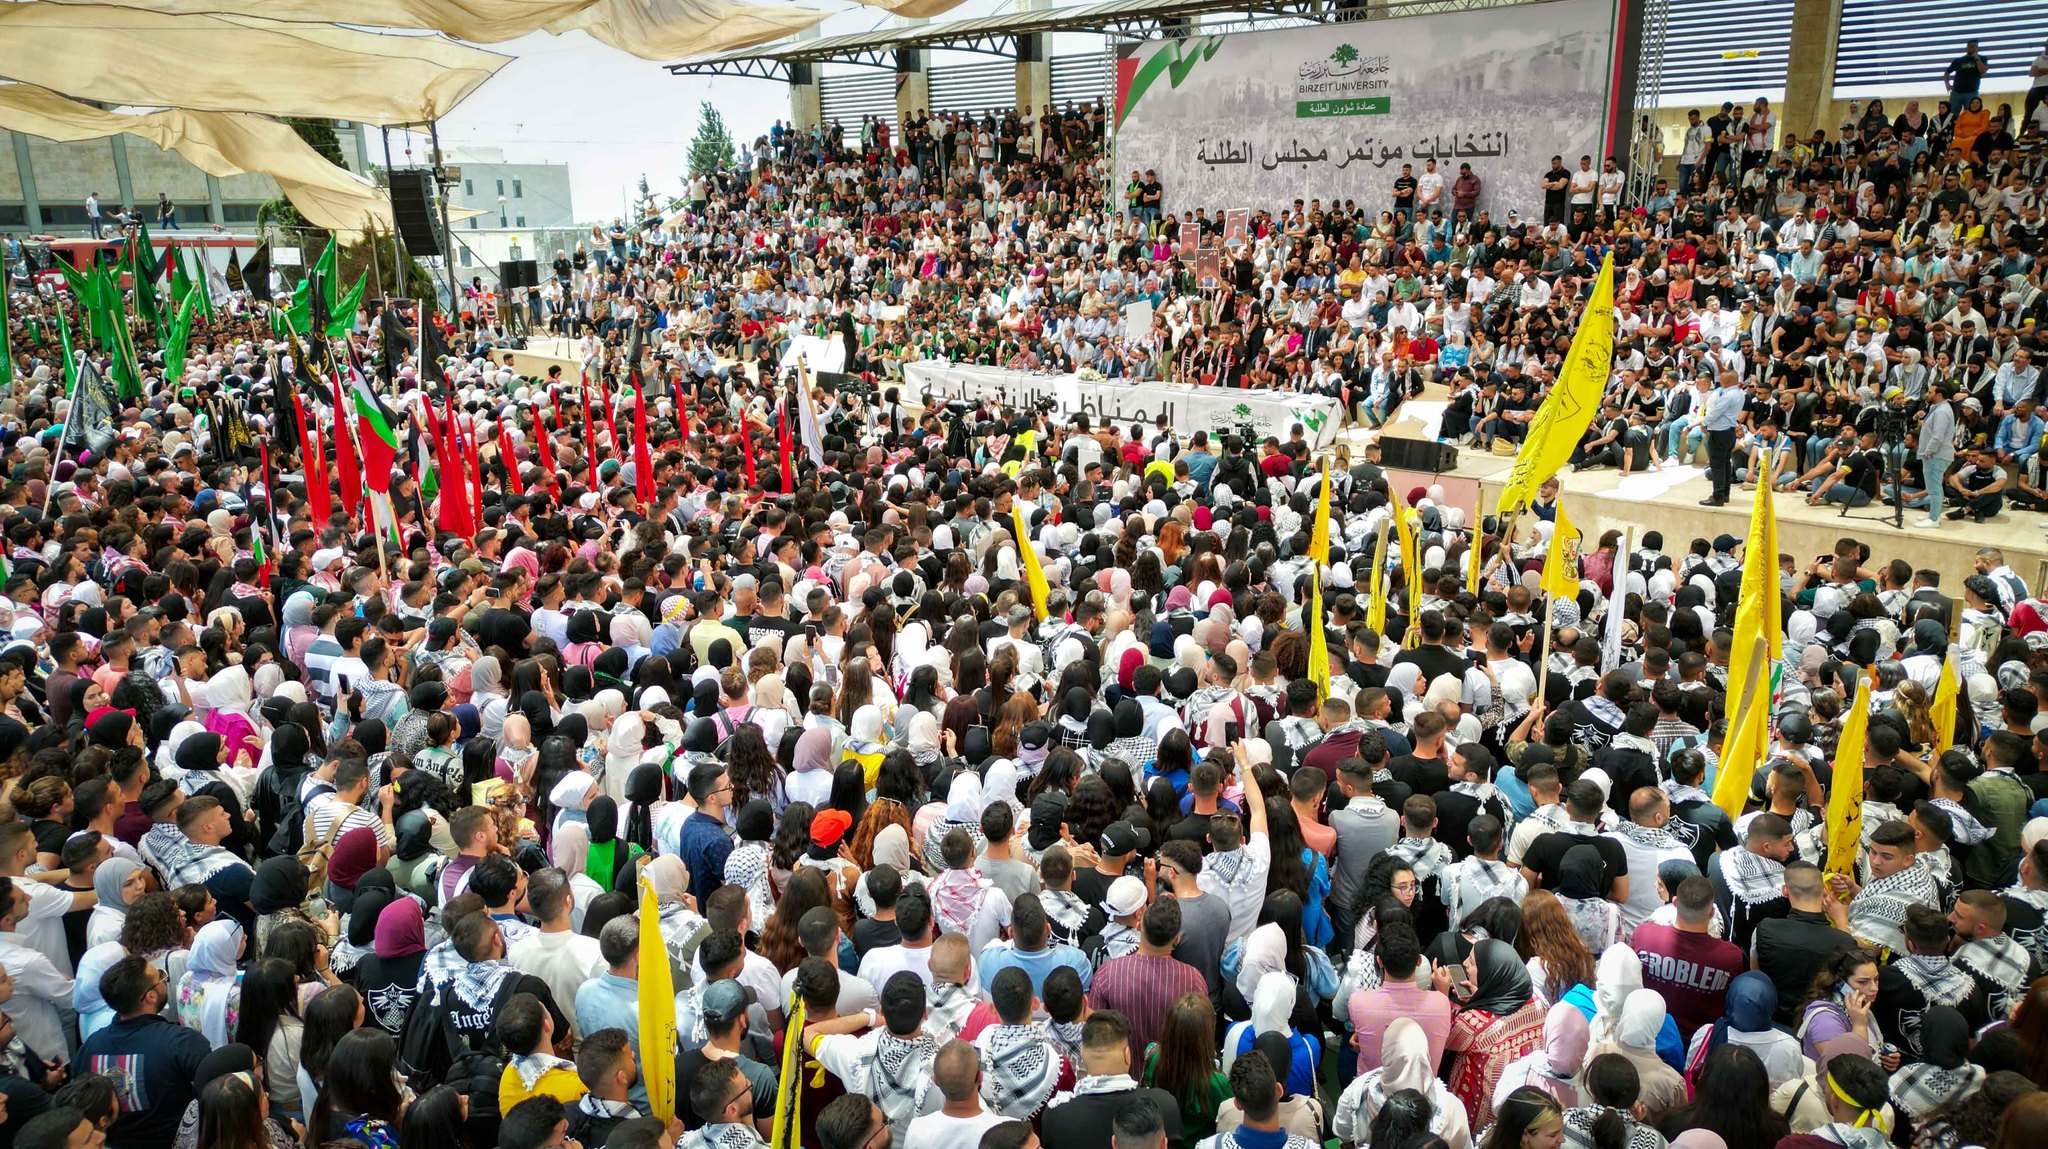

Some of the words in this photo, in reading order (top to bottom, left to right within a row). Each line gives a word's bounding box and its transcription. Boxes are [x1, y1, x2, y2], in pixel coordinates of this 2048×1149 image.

[1299, 83, 1333, 93] BIRZEIT
[1335, 80, 1389, 91] UNIVERSITY
[1309, 103, 1330, 114] الطلبة
[1332, 102, 1355, 115] شؤون
[1357, 101, 1376, 111] عمادة
[1196, 138, 1253, 171] الطلبة
[1261, 138, 1328, 170] مجلس
[1335, 137, 1402, 169] مؤتمر
[1412, 131, 1508, 166] انتخابات
[1047, 391, 1174, 427] المناظرة
[1638, 950, 1731, 991] PROBLEM
